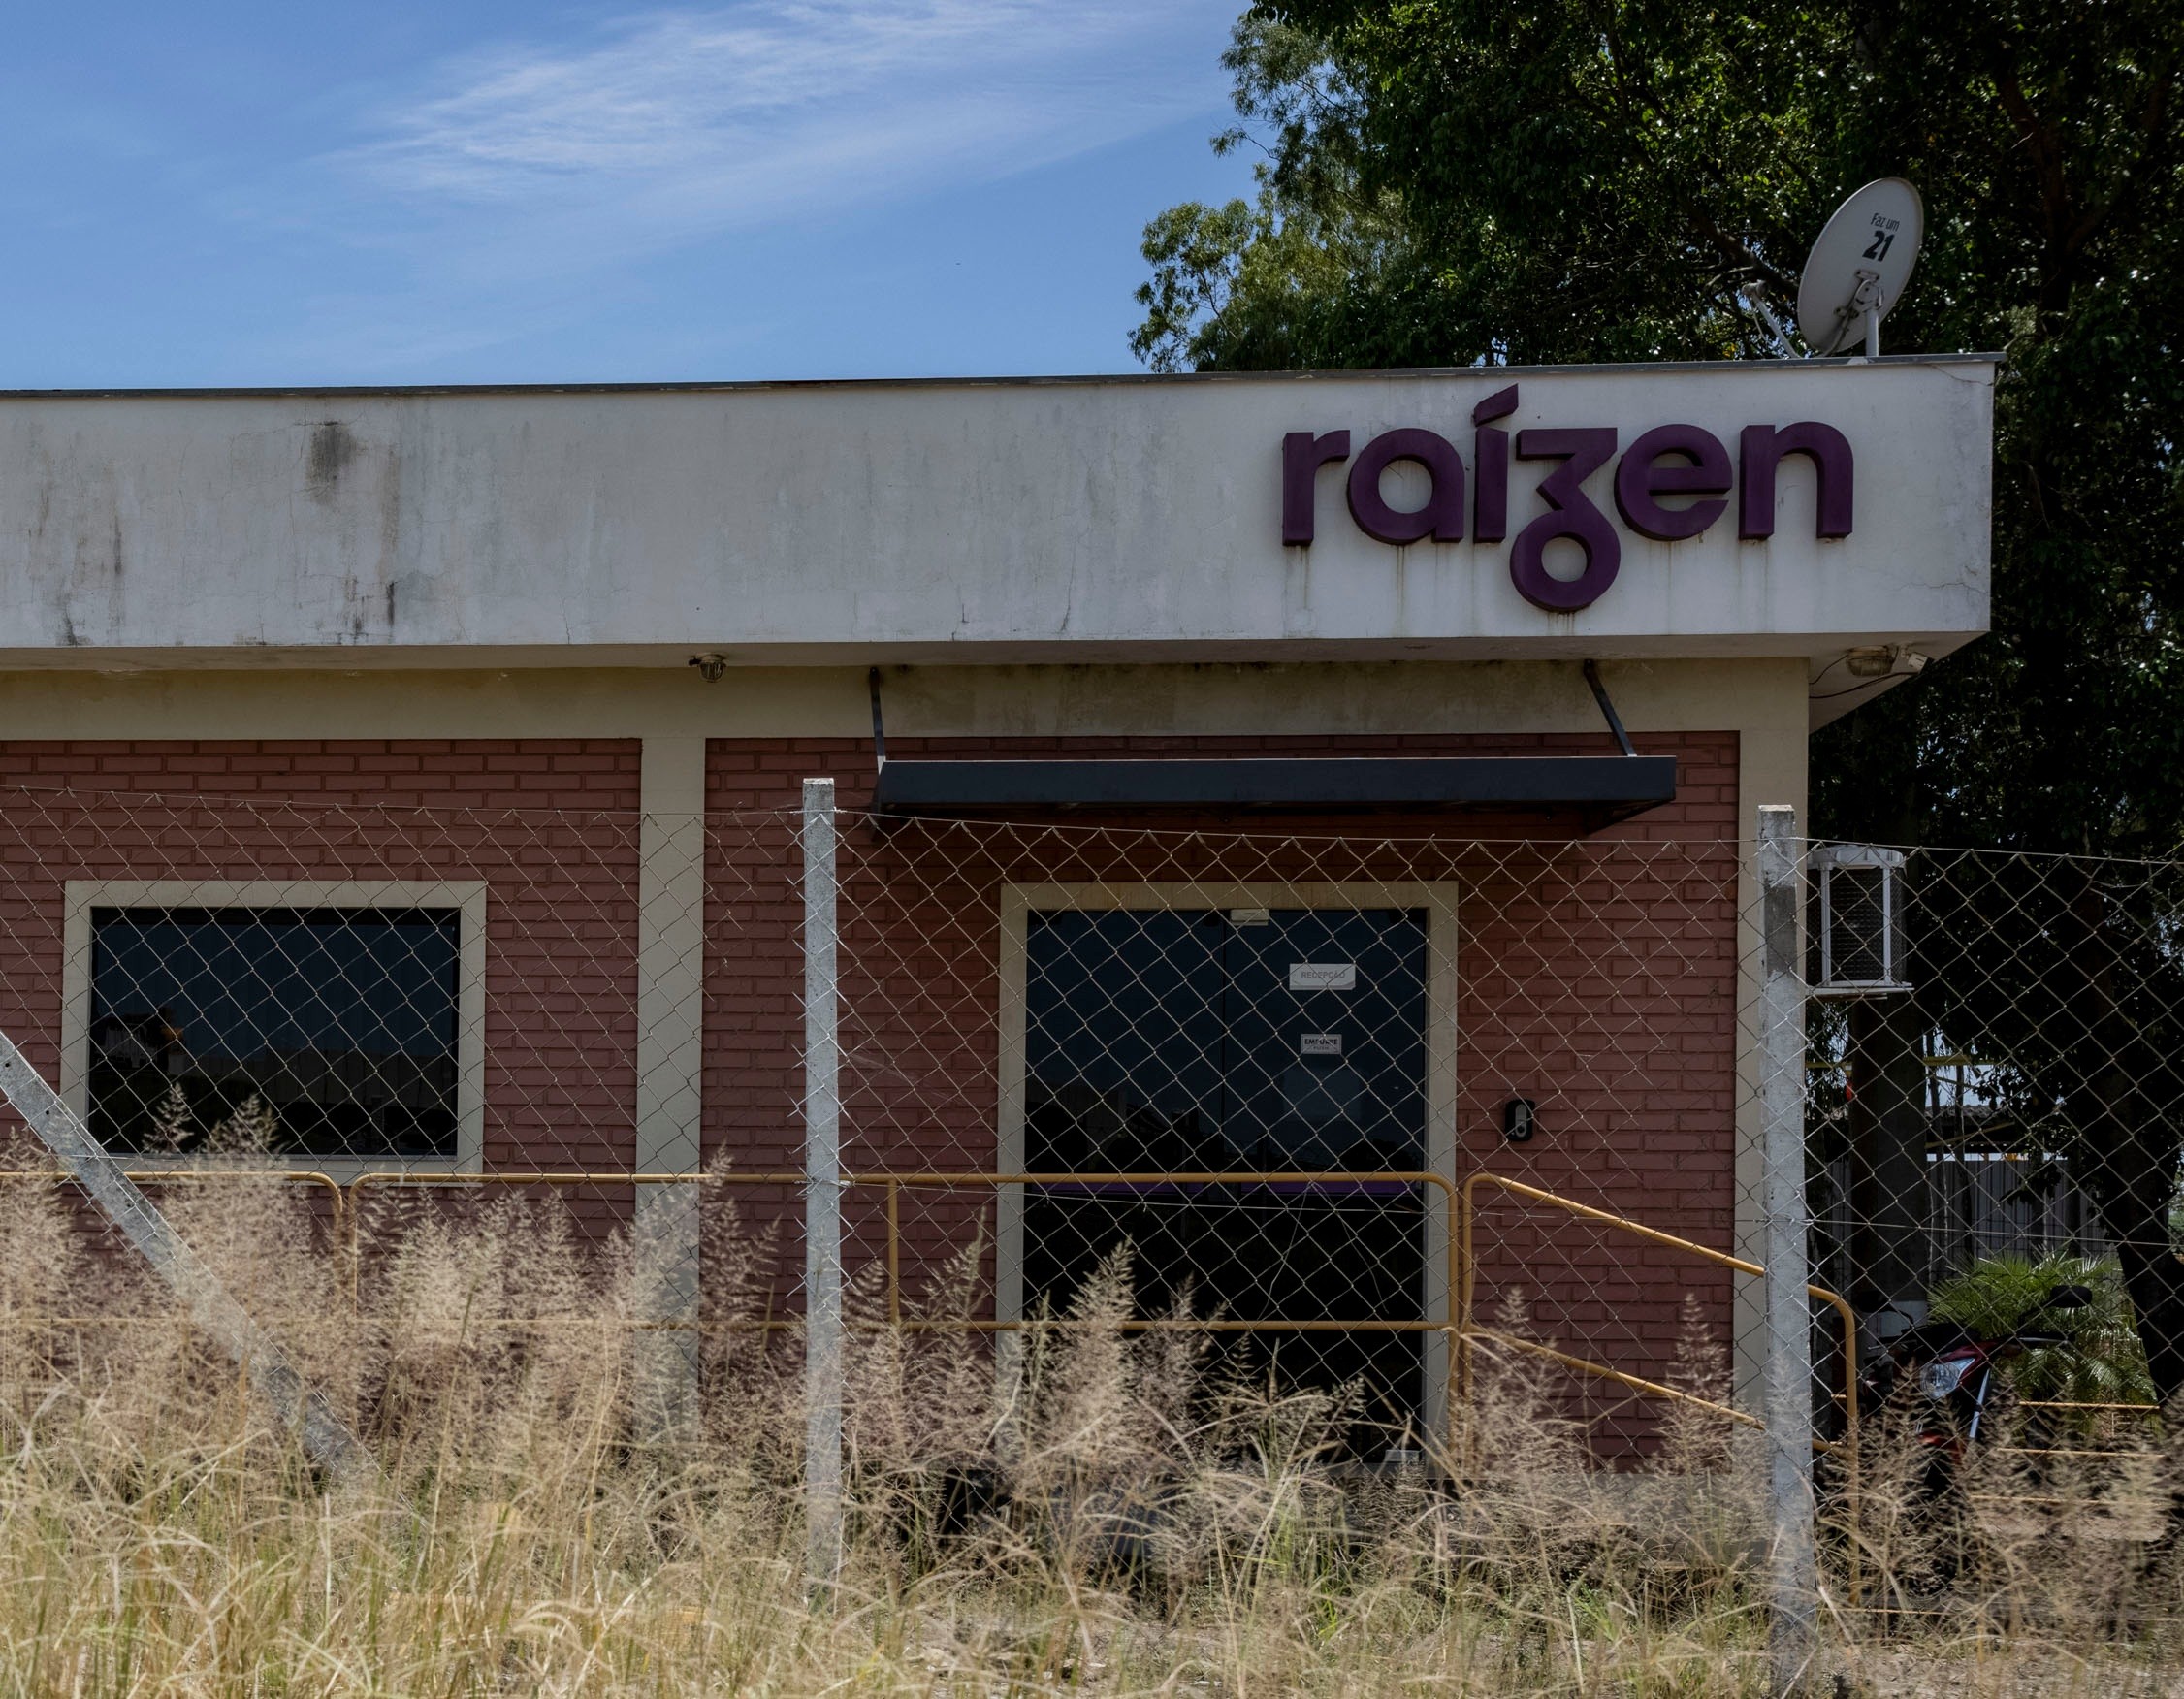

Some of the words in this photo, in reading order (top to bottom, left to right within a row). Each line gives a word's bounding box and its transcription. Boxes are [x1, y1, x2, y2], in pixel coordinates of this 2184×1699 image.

[1870, 212, 1886, 228] Faz
[1885, 218, 1901, 232] um
[1862, 230, 1895, 262] 21
[1282, 383, 1854, 611] raízen
